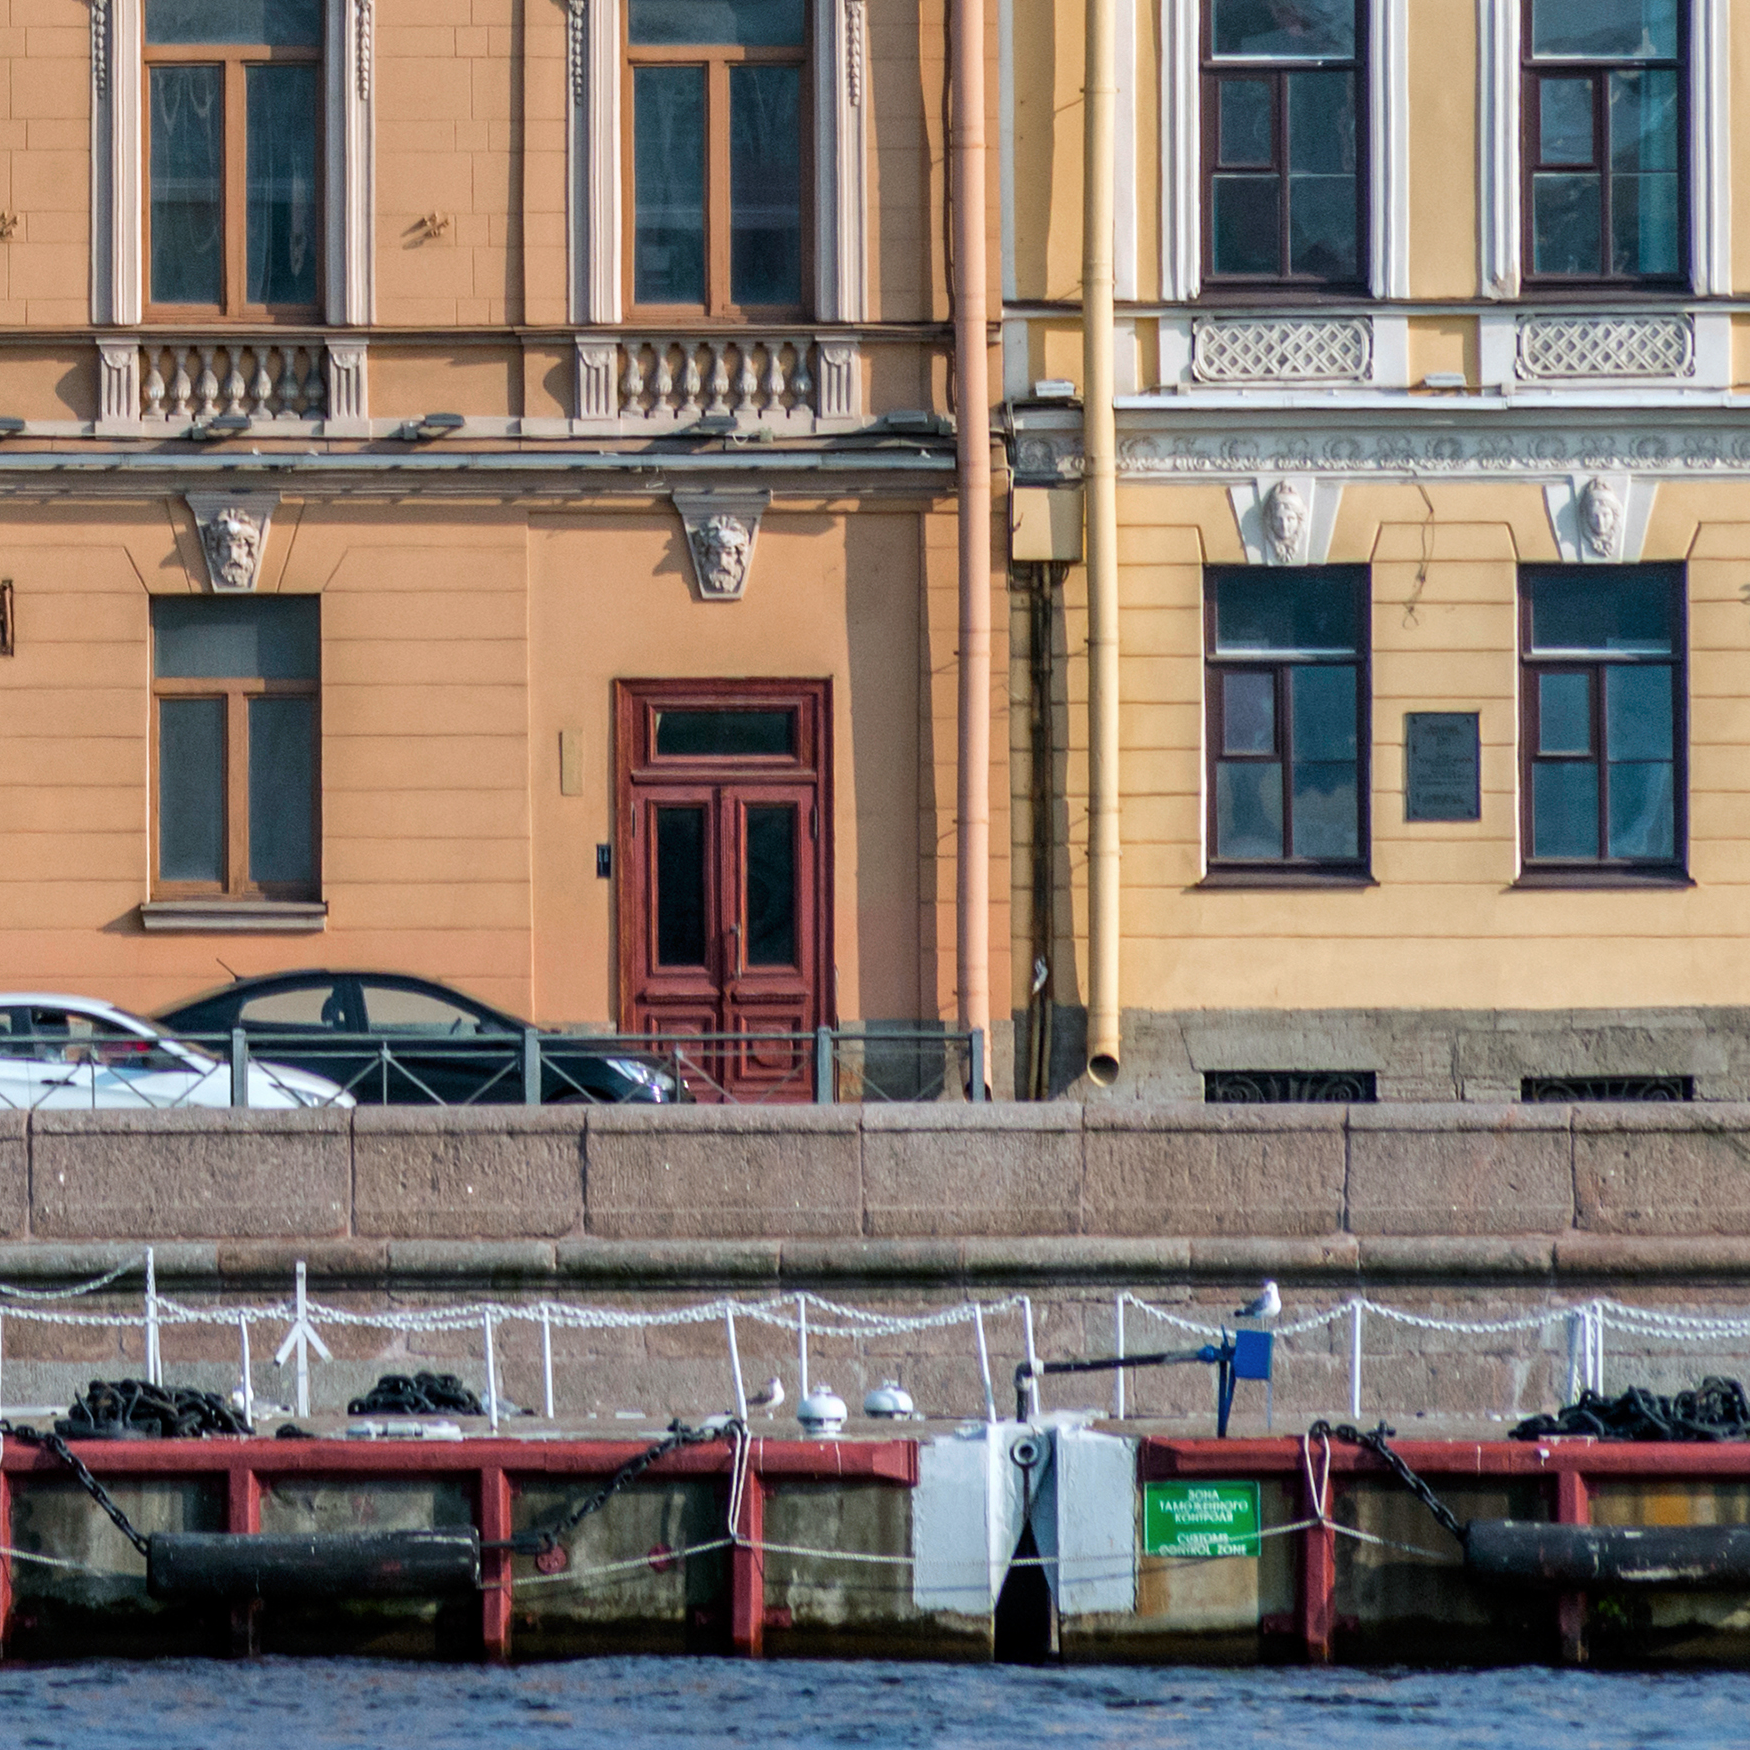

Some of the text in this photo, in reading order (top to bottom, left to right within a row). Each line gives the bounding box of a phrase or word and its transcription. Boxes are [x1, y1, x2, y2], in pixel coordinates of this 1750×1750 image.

[1188, 1489, 1220, 1501] ЗОНА
[1159, 1500, 1248, 1512] ТАМОЖЕННОГО
[1174, 1510, 1234, 1524] КОНТРОЛЯ
[1177, 1532, 1229, 1545] CUSTOMS
[1158, 1544, 1247, 1556] CONTROL ZONE
